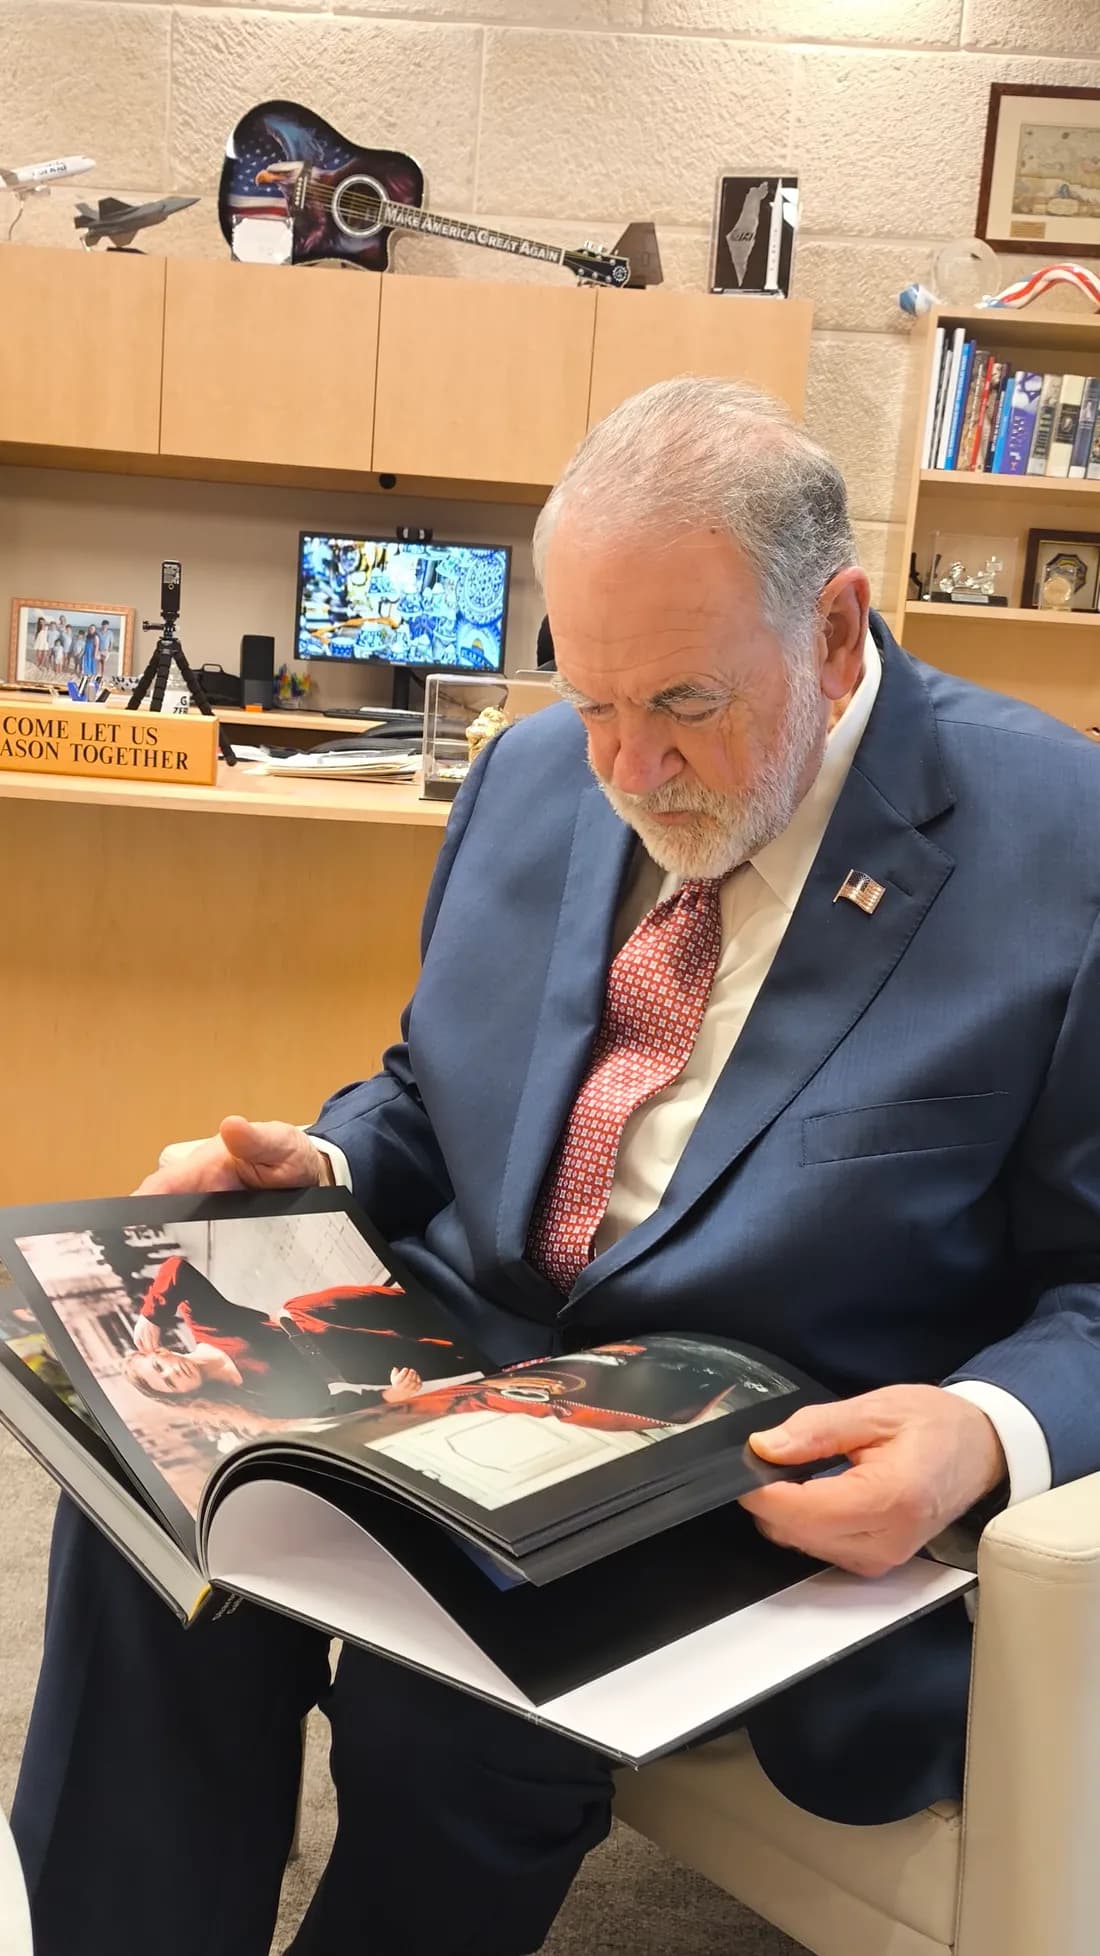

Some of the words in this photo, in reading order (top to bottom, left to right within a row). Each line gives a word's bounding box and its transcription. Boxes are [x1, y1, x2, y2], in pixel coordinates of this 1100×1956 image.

[519, 240, 559, 262] AGAIN
[3, 716, 69, 740] COME
[81, 721, 121, 743] LET
[132, 726, 158, 746] US
[70, 743, 189, 771] TOGETHER
